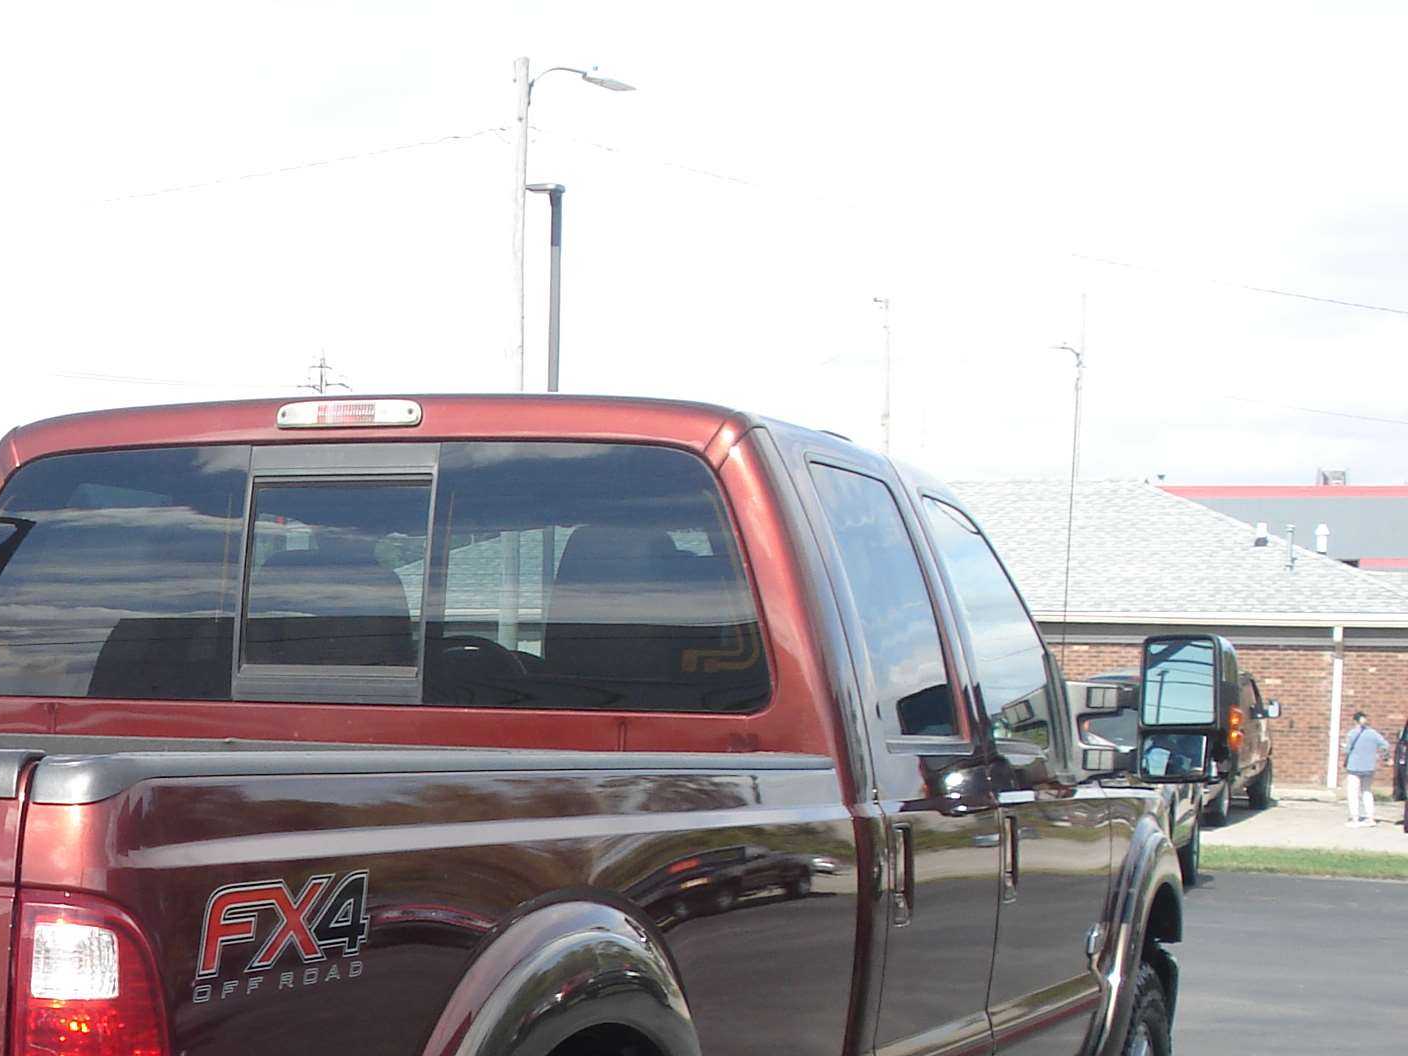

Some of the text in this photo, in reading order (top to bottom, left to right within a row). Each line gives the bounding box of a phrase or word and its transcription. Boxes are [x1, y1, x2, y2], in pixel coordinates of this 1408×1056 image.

[195, 868, 371, 981] FX4
[192, 960, 364, 1004] OFF ROAD
